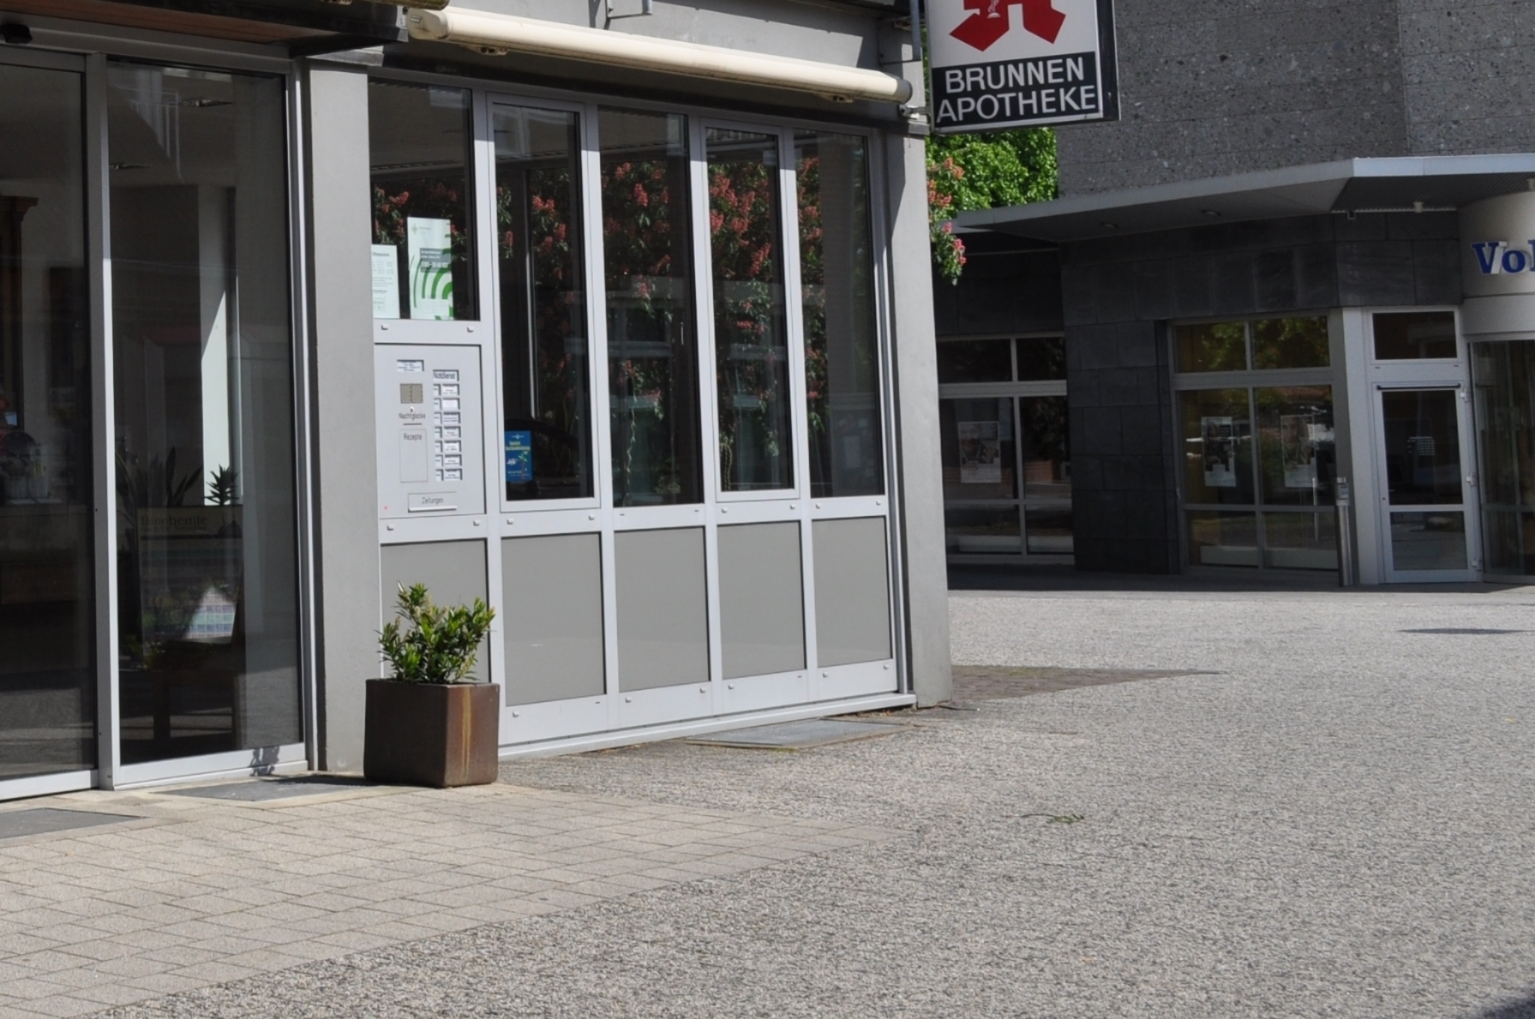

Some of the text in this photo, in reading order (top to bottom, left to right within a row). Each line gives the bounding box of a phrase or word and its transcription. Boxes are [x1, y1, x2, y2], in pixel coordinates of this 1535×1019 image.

[945, 56, 1085, 94] BRUNNEN
[936, 85, 1097, 124] APOTHEKE
[403, 433, 423, 441] Rezepte
[422, 496, 444, 505] Zeitungen
